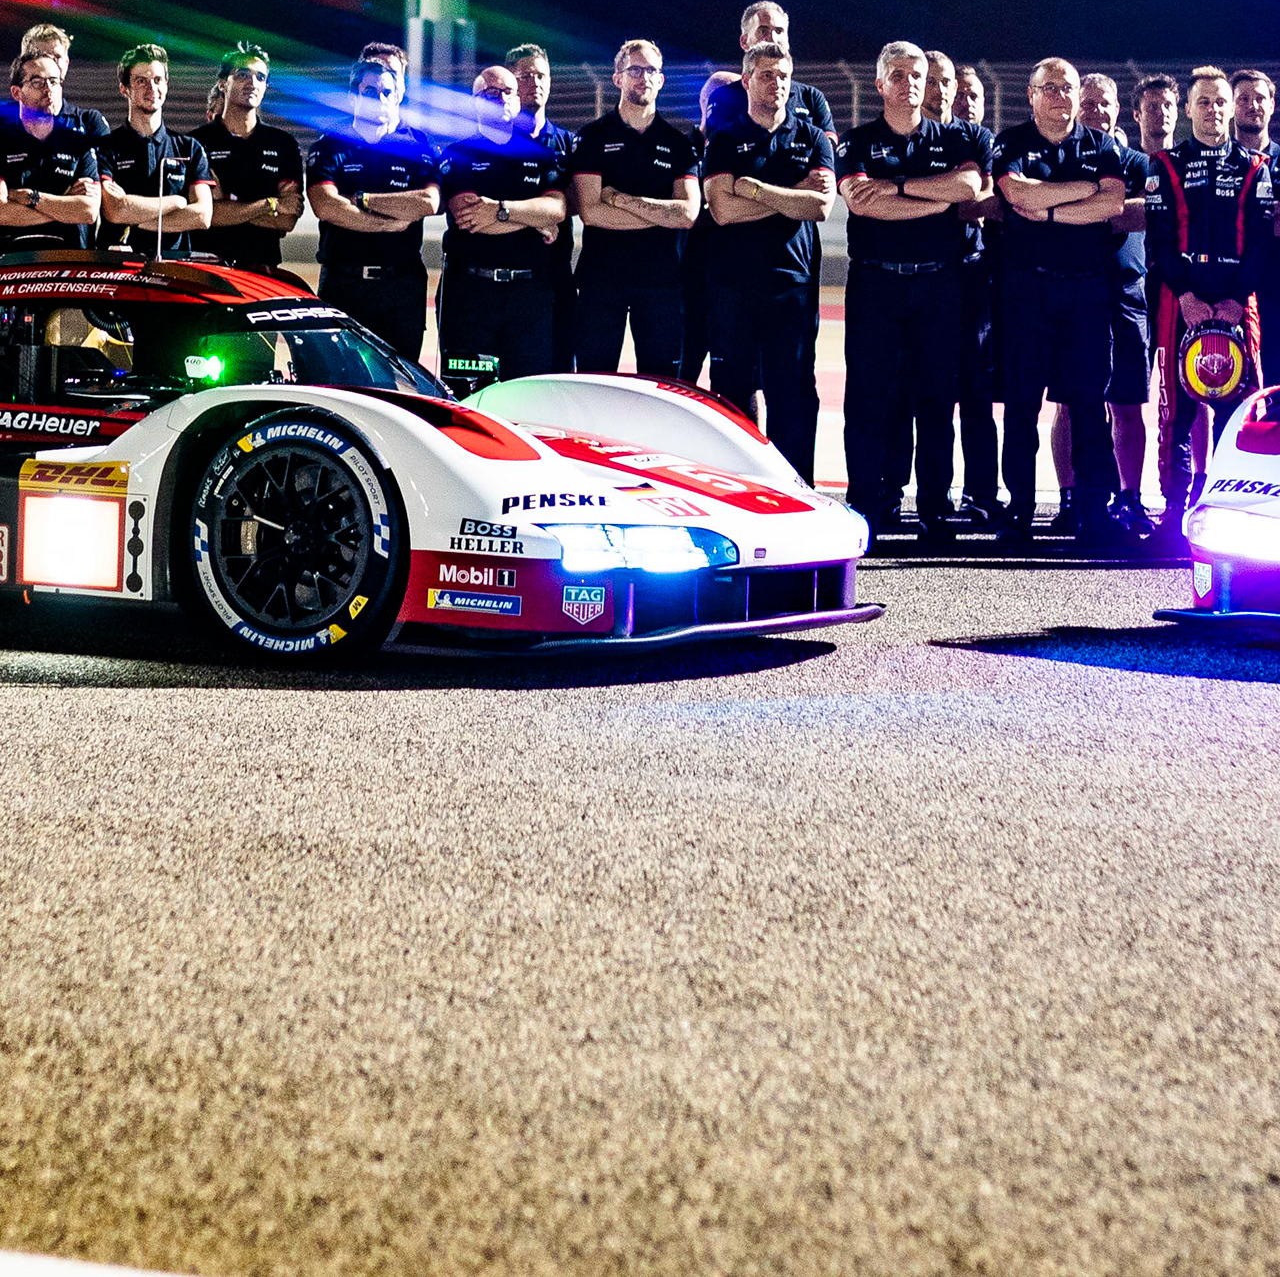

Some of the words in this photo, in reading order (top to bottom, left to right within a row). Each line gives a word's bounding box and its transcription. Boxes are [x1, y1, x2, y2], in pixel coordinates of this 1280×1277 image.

[1216, 189, 1234, 197] BOSS
[2, 285, 18, 295] M.
[18, 283, 99, 294] CHRISTENSEN
[447, 359, 494, 372] HELLER
[266, 424, 345, 450] MICHELIN
[30, 464, 117, 487] DHL
[349, 454, 368, 476] PILOT
[365, 475, 380, 507] SPORT
[667, 464, 748, 493] 5
[501, 493, 612, 515] PENSKE
[641, 498, 703, 517] HY
[463, 521, 514, 537] BOSS
[449, 536, 524, 554] HELLER
[439, 564, 494, 586] Mobil
[453, 597, 514, 610] MICHELIN
[566, 589, 602, 602] TAG
[564, 602, 602, 622] HEUER
[238, 626, 316, 652] MICHELIN
